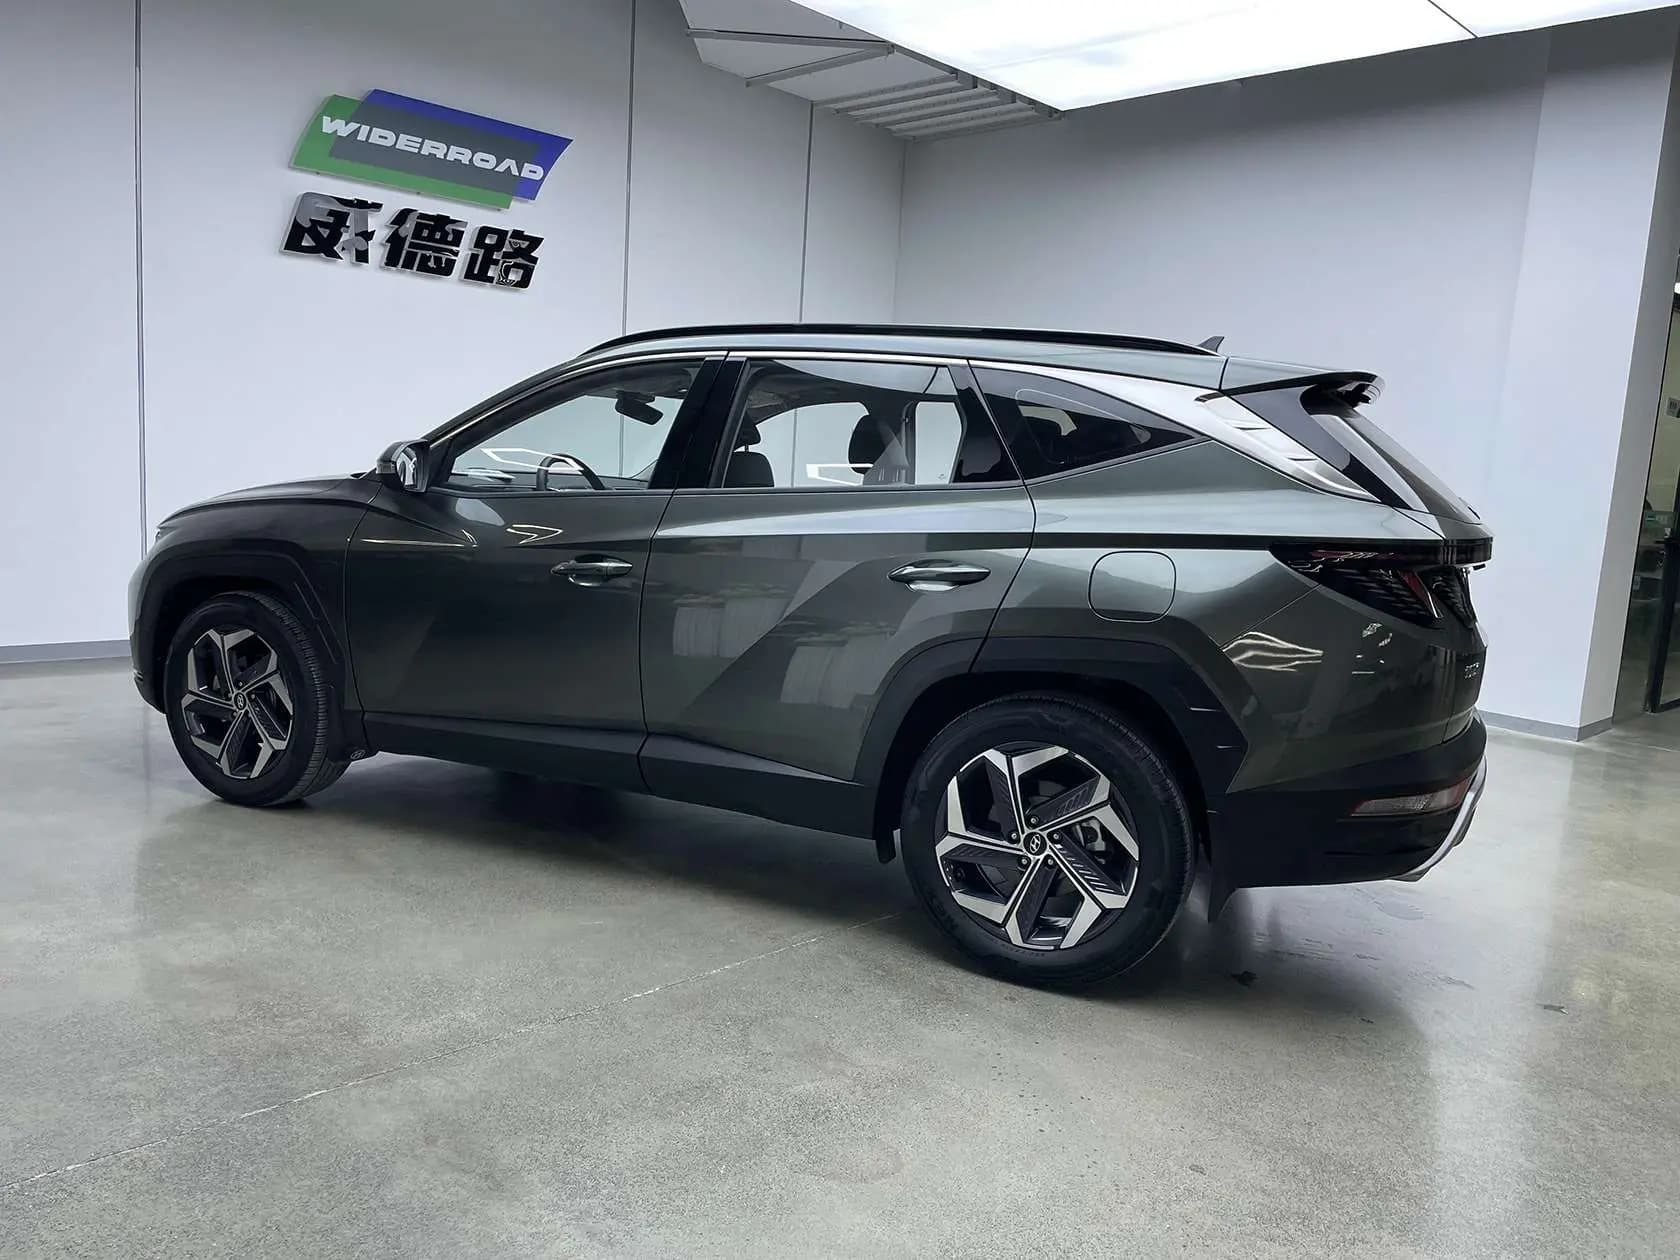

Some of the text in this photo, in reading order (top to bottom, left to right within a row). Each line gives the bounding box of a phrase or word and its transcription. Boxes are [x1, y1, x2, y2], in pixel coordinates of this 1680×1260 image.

[321, 115, 544, 181] WIDERROAD
[280, 191, 545, 290] 威德路
